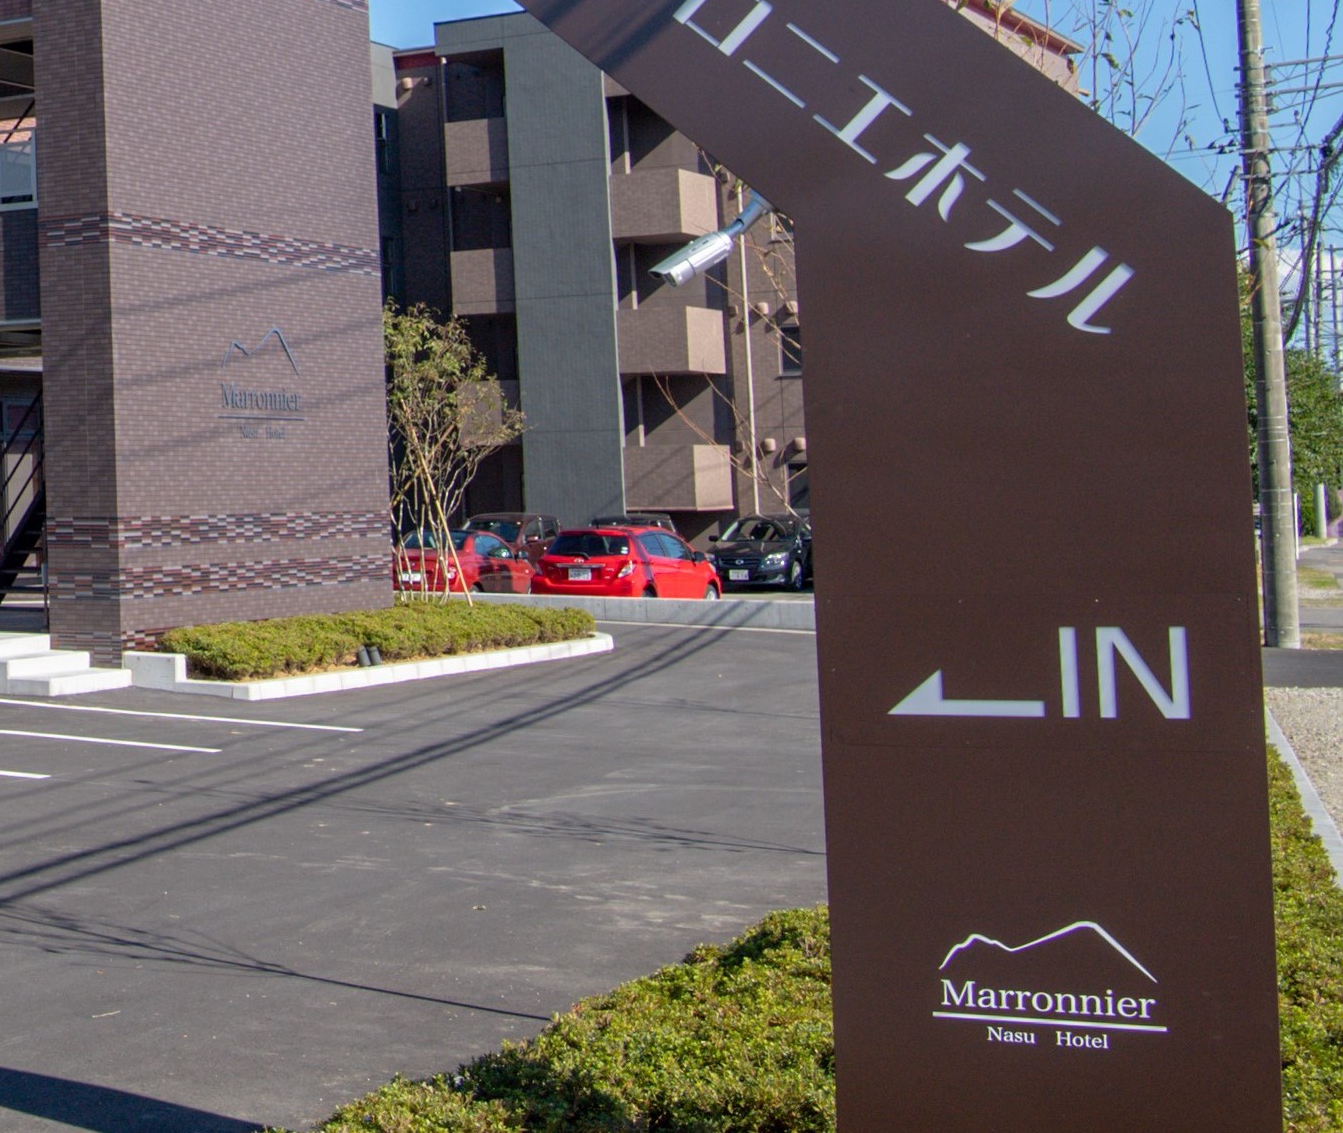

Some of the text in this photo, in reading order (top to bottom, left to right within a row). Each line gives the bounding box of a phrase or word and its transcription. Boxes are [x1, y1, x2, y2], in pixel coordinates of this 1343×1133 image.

[220, 381, 302, 411] Marronnier
[1058, 626, 1191, 720] IN
[940, 978, 1156, 1019] Marronnier
[987, 1025, 1109, 1049] Nasu Hotel
